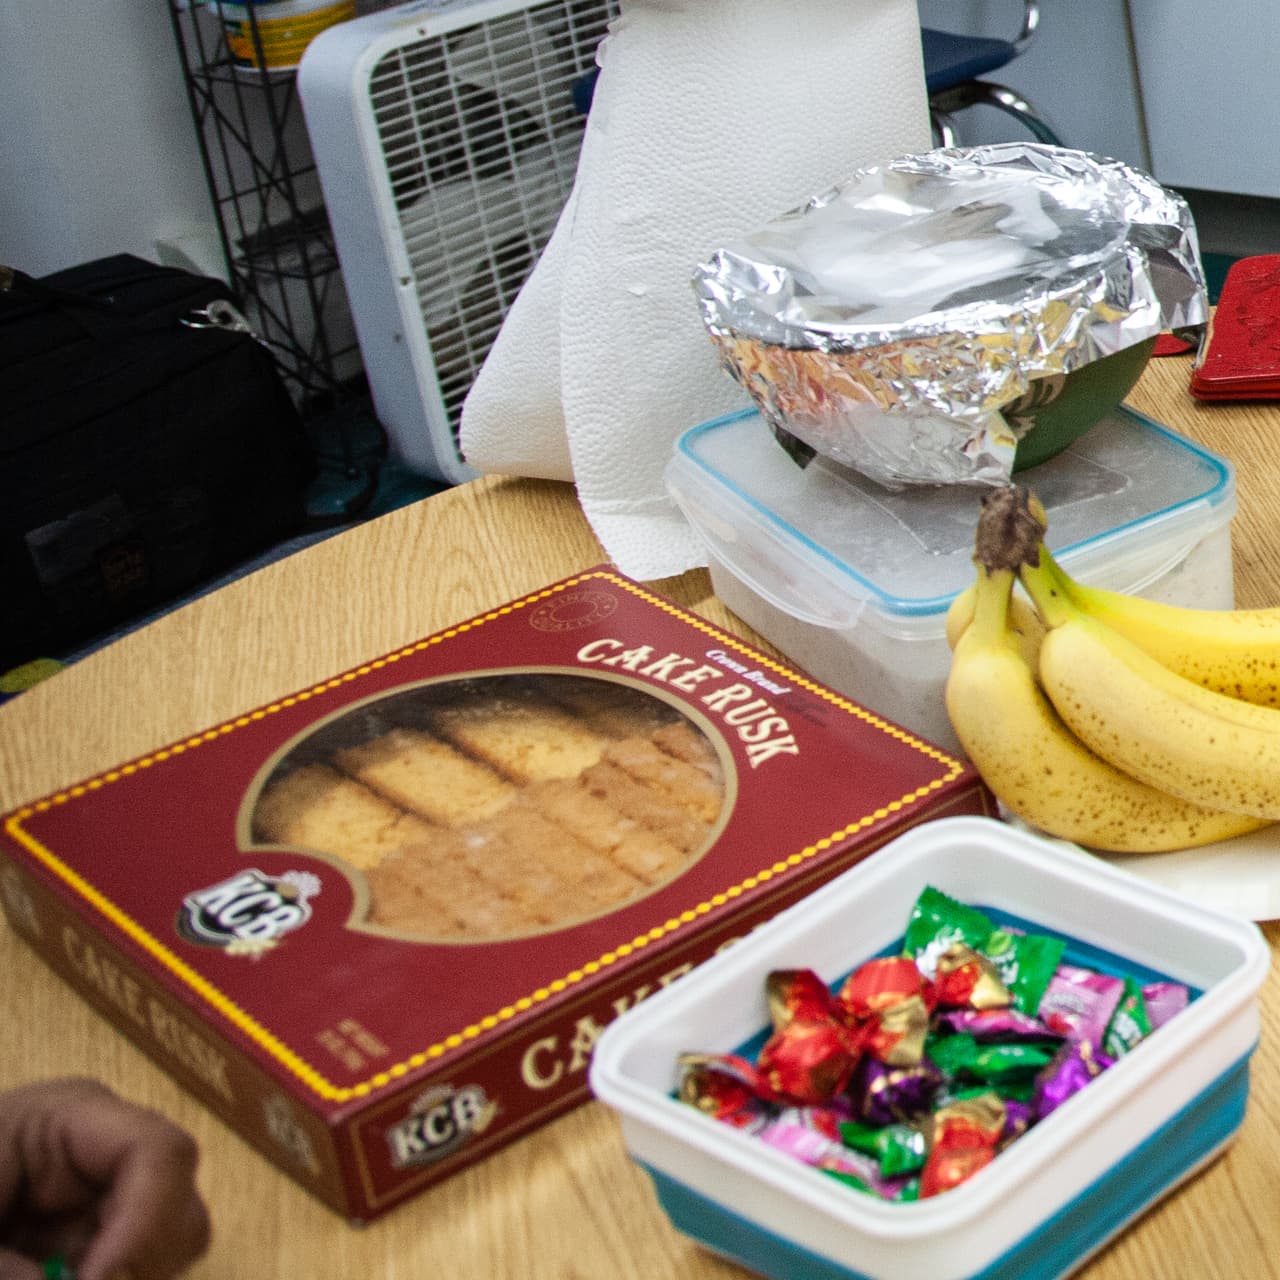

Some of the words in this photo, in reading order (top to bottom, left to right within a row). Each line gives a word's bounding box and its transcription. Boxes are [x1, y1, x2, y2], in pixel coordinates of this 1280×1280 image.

[576, 638, 724, 694] CAKE
[701, 682, 799, 769] RUSK
[741, 670, 792, 695] Brand
[190, 872, 305, 942] KCB
[387, 1086, 486, 1163] KCB
